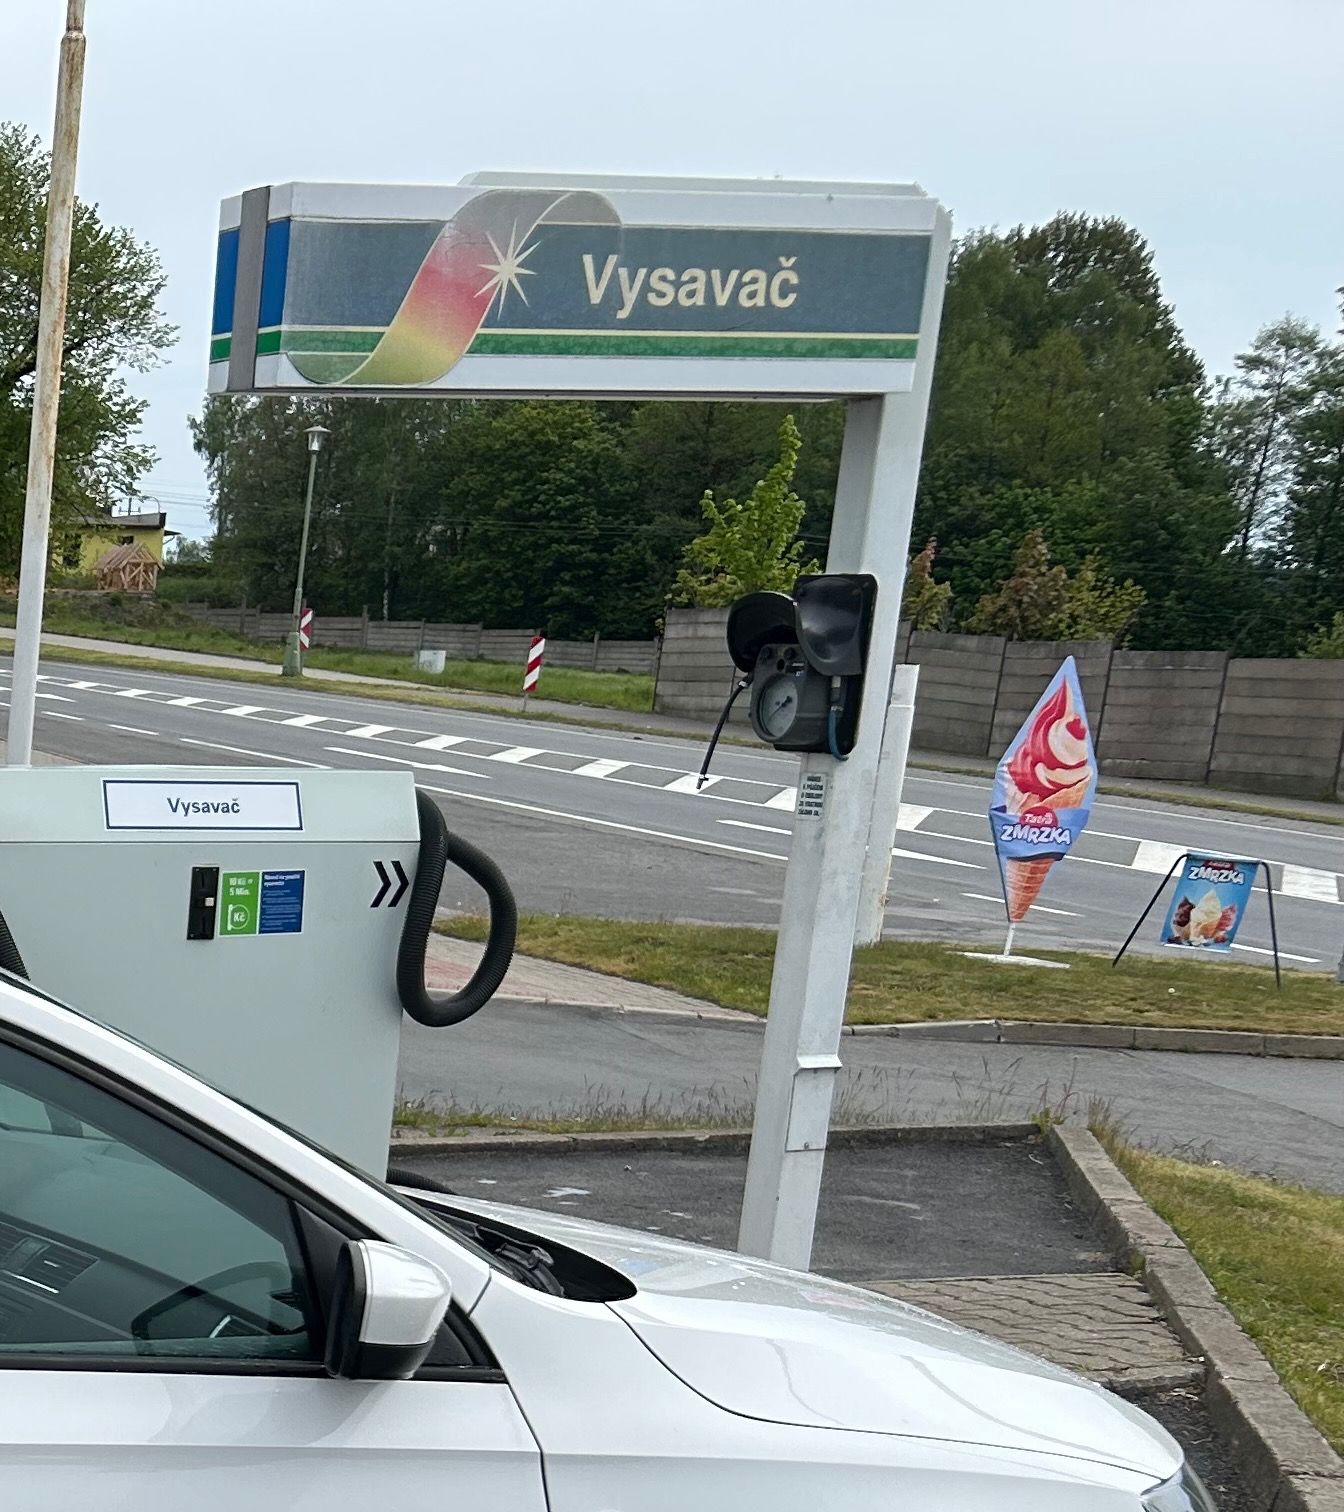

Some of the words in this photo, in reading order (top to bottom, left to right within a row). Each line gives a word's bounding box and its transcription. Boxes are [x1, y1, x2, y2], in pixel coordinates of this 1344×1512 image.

[582, 254, 800, 319] Vysavač
[167, 797, 240, 817] Vysavač
[1000, 824, 1071, 845] ZMRZKA
[1188, 866, 1244, 885] ZMRZKA
[233, 911, 246, 922] Kč
